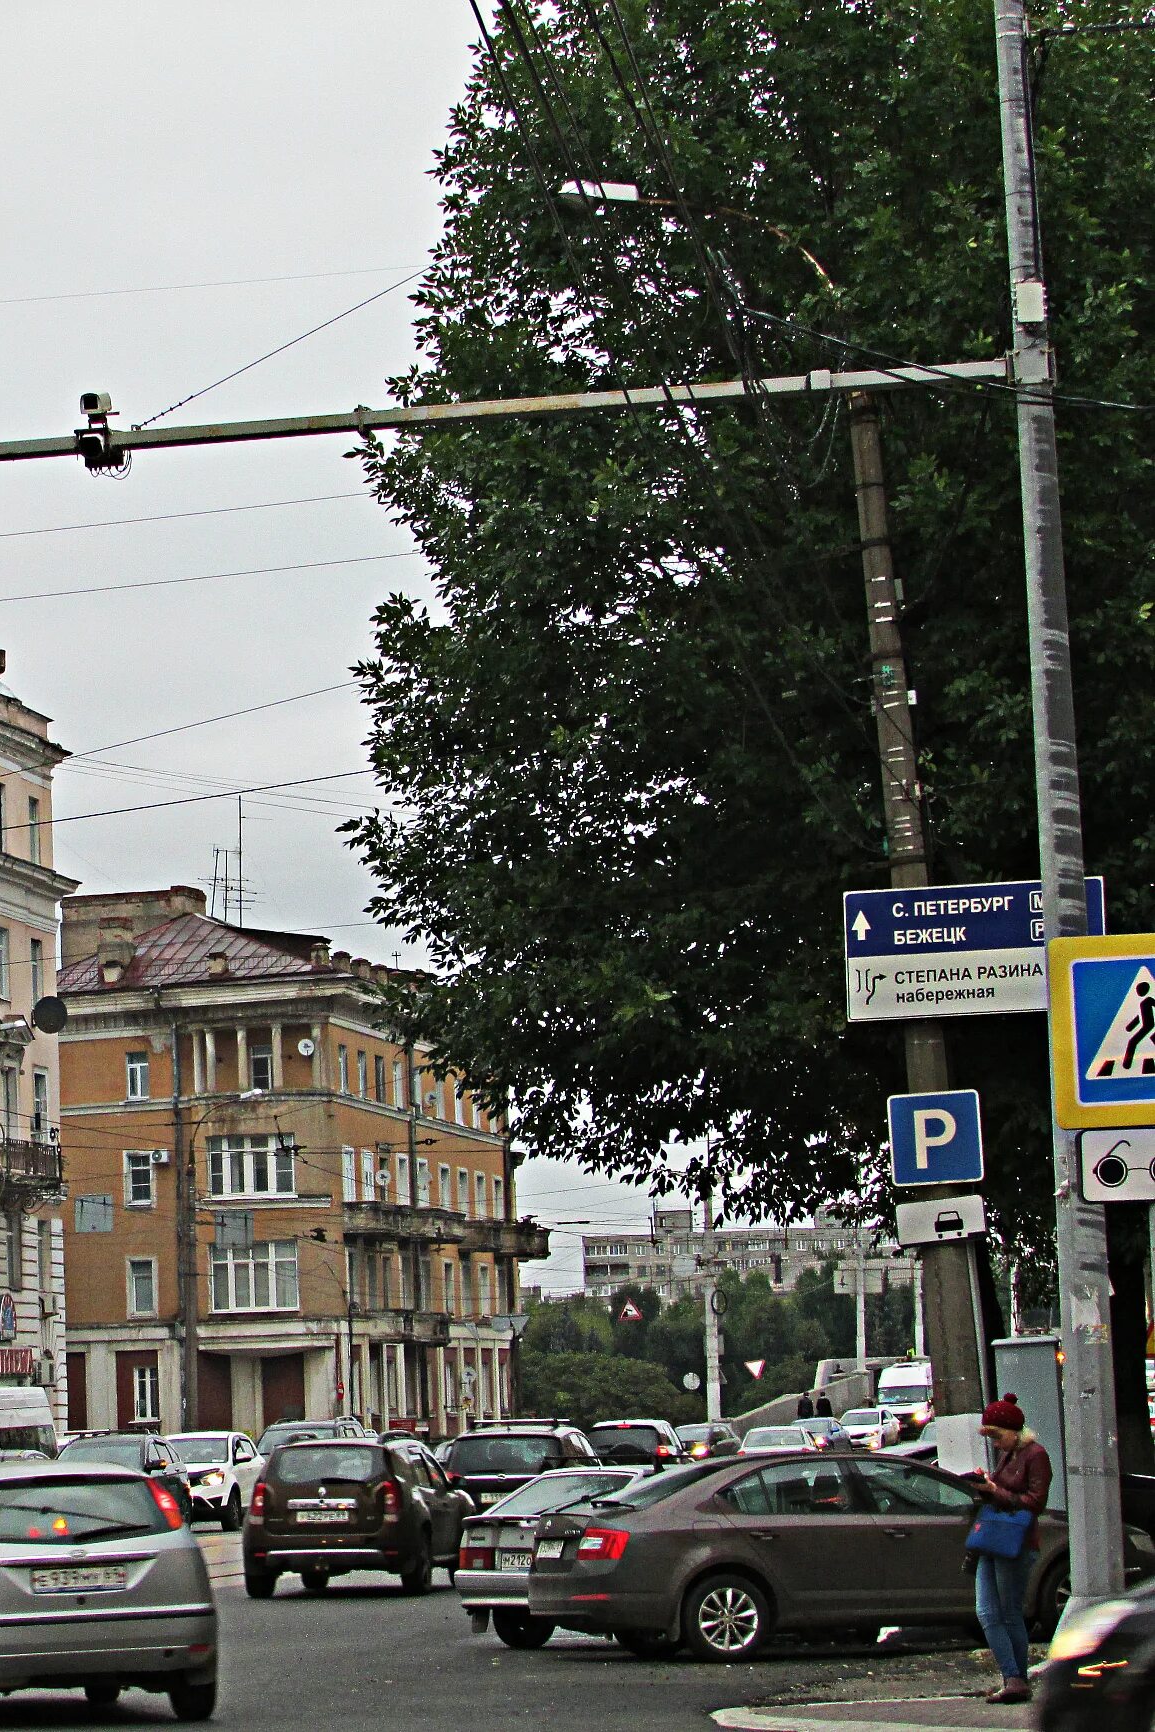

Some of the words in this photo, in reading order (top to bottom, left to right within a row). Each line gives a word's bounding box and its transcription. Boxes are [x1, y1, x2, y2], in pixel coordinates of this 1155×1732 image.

[892, 901, 909, 918] С.
[913, 896, 1014, 917] ПЕТЕРБУРГ
[894, 926, 967, 945] БЕЖЕЦК
[895, 966, 973, 985] СТЕПАНА
[978, 962, 1043, 980] РАЗИНА
[896, 986, 996, 1004] набережная
